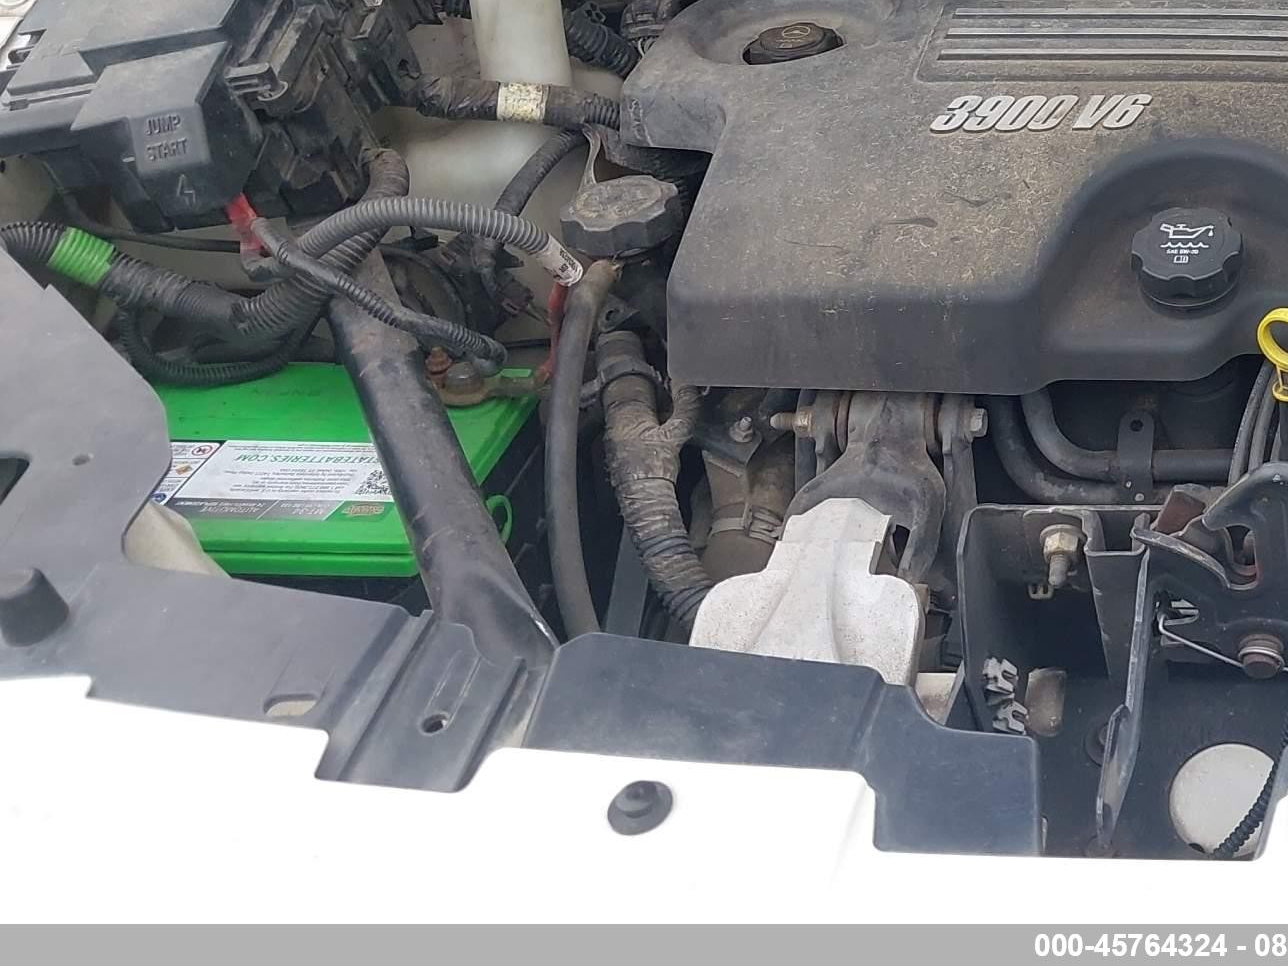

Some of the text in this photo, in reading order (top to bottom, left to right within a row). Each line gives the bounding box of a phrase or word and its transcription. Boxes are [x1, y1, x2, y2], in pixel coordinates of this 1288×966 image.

[145, 114, 181, 135] JUMP
[930, 93, 1153, 133] 3900 V6
[146, 137, 187, 161] START
